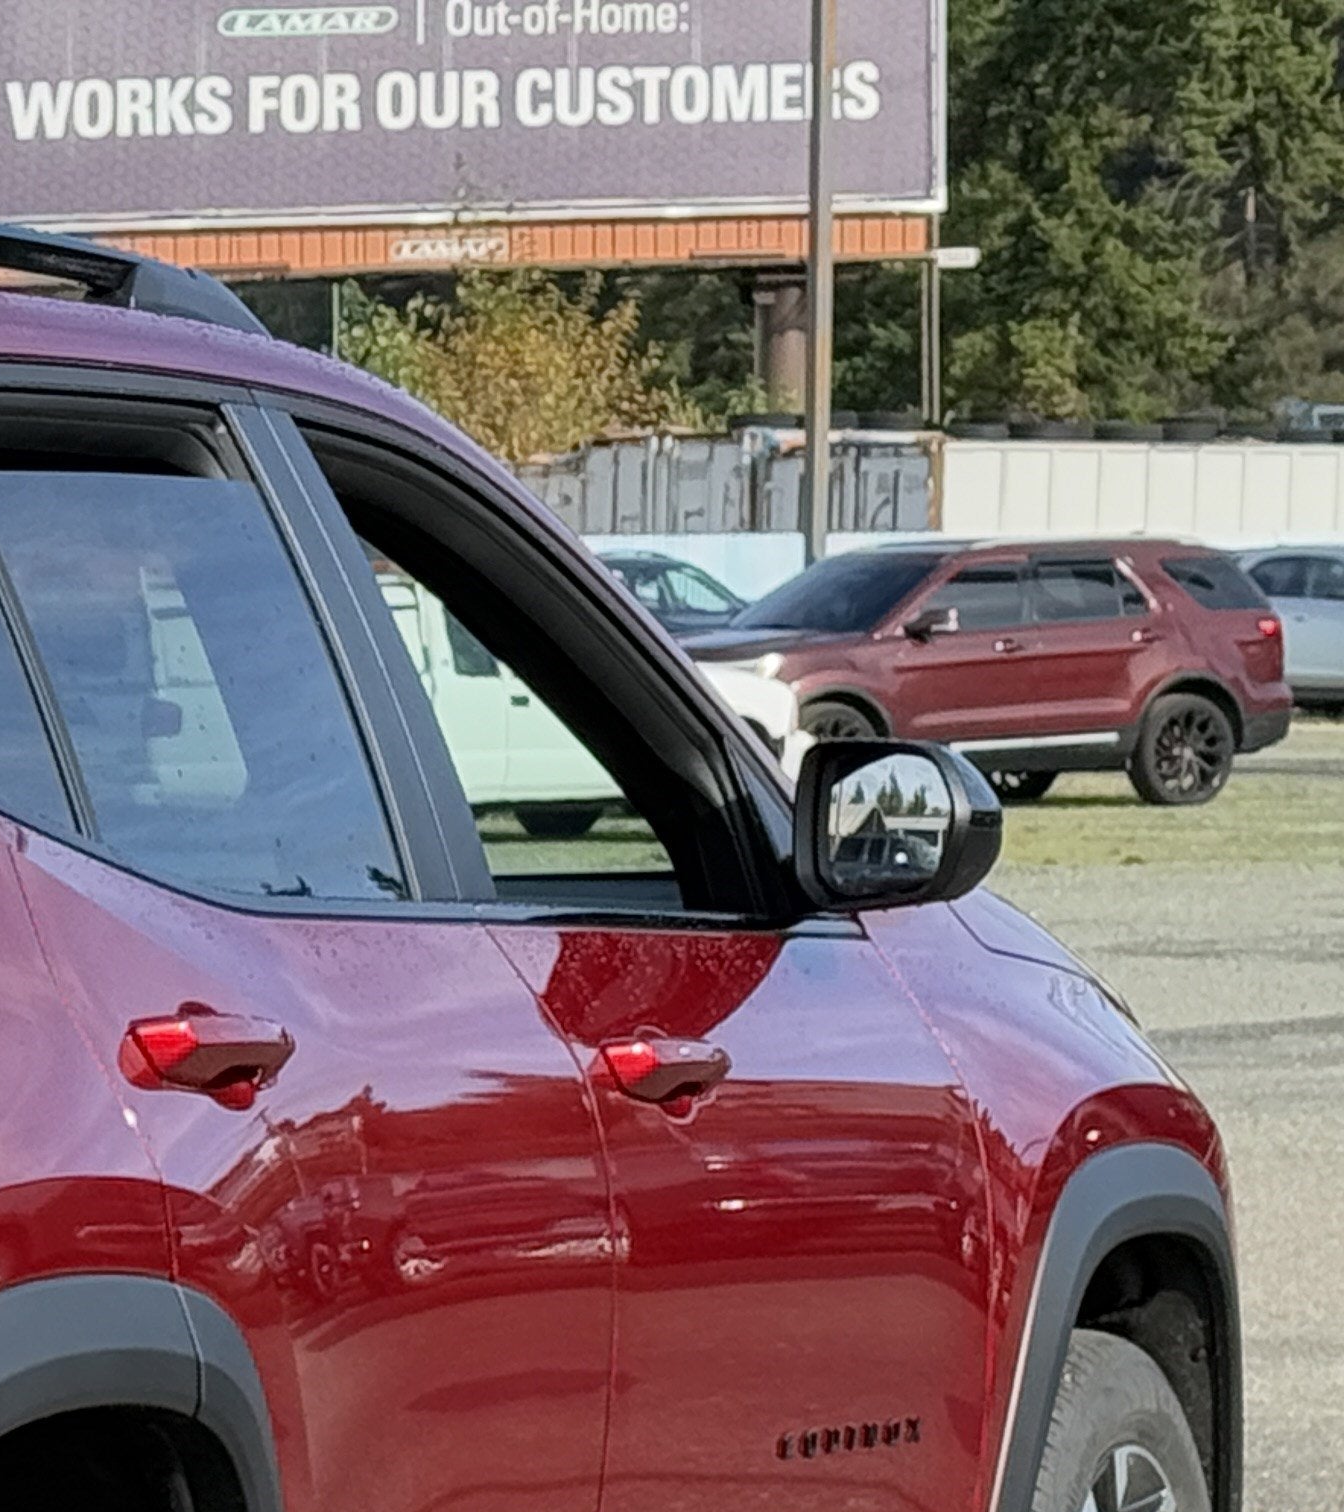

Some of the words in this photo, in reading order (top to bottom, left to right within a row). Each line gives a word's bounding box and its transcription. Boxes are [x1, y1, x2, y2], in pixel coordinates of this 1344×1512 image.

[230, 8, 382, 34] LAMAR
[446, 0, 689, 37] Out-of-Home:
[5, 75, 233, 140] WORKS
[248, 74, 362, 134] FOR
[376, 69, 500, 130] OUR
